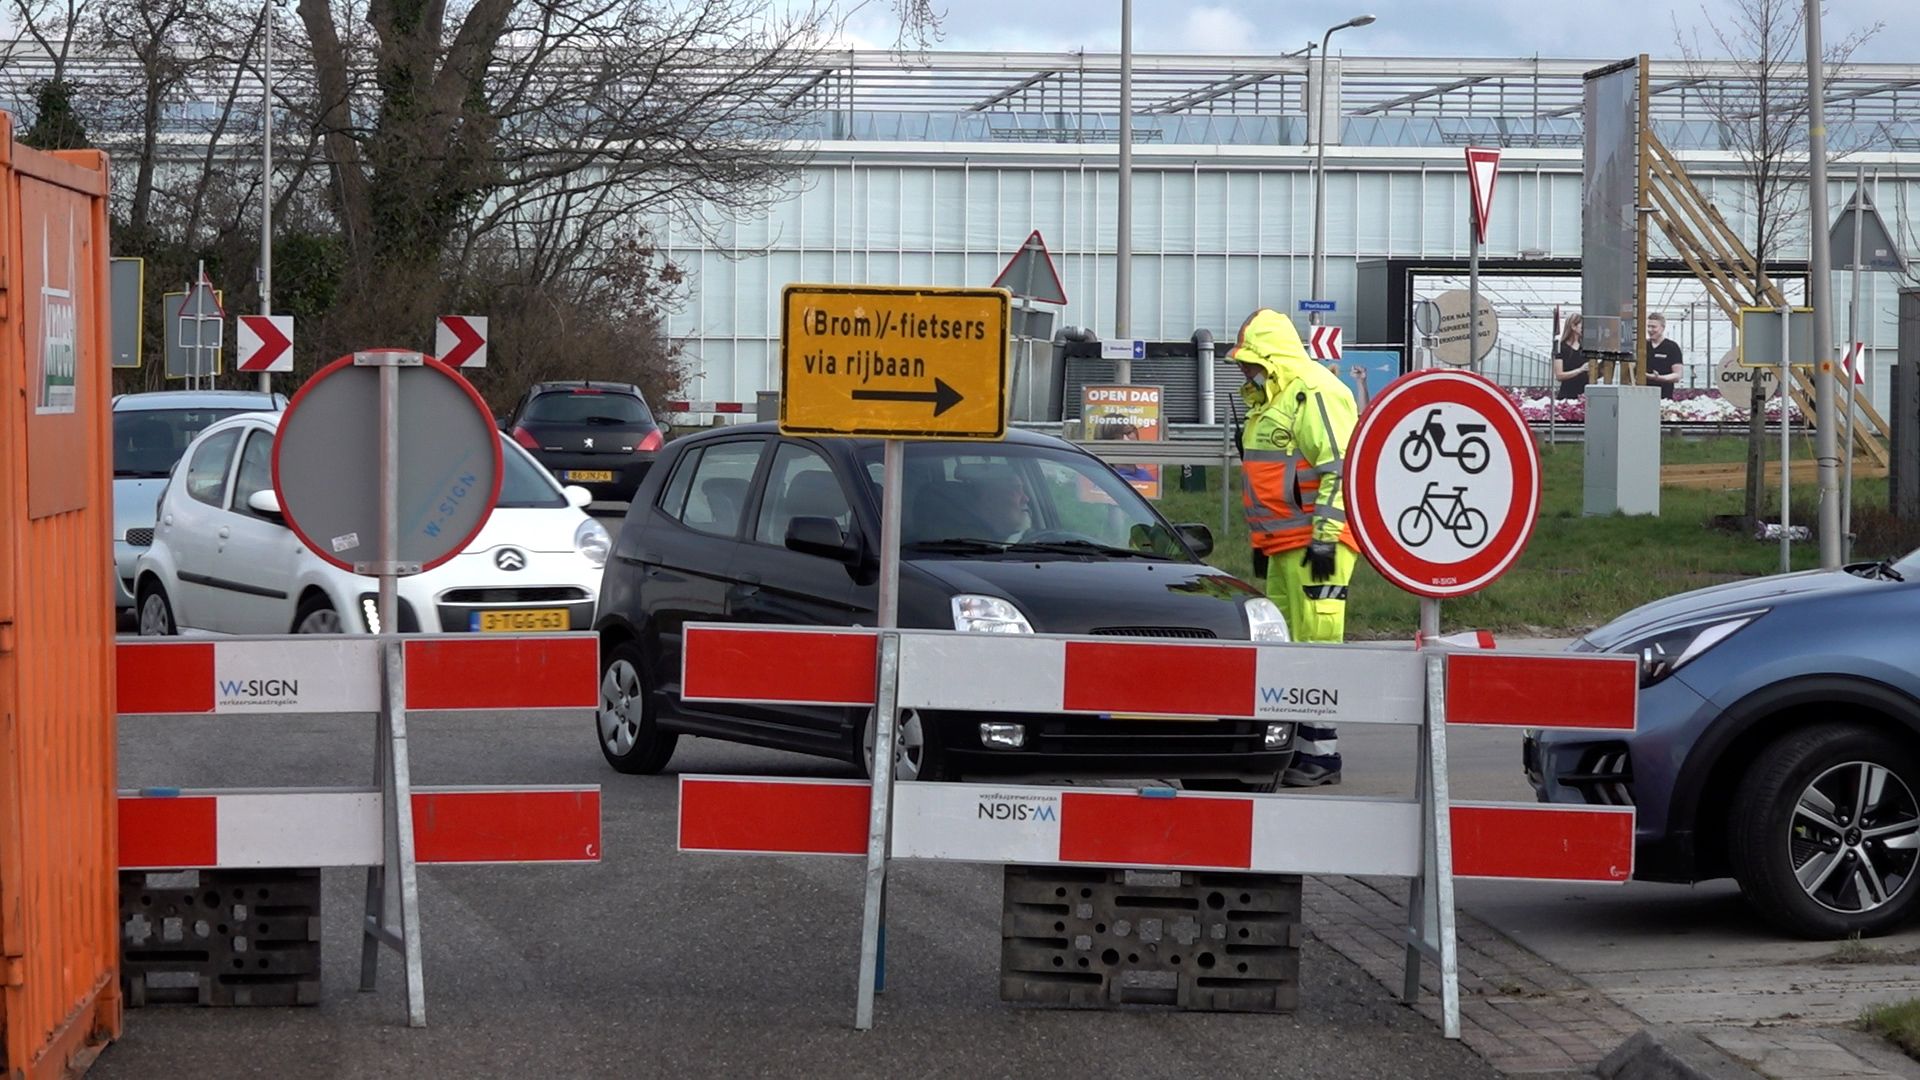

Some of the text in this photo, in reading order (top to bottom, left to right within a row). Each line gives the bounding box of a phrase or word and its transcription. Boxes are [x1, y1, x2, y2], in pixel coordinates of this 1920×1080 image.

[804, 310, 985, 340] (Brom)/-fietsers
[804, 350, 925, 384] via rijbaan
[1088, 390, 1159, 403] OPEN DAG
[1089, 414, 1157, 428] Floracollege
[424, 473, 476, 537] W-SIGN
[219, 680, 298, 696] W-SIGN
[219, 698, 298, 707] verkeersmaatregelen
[1261, 688, 1338, 706] W-SIGN
[1260, 705, 1337, 715] verkeersmaatregelen
[979, 803, 1056, 821] W-SIGN
